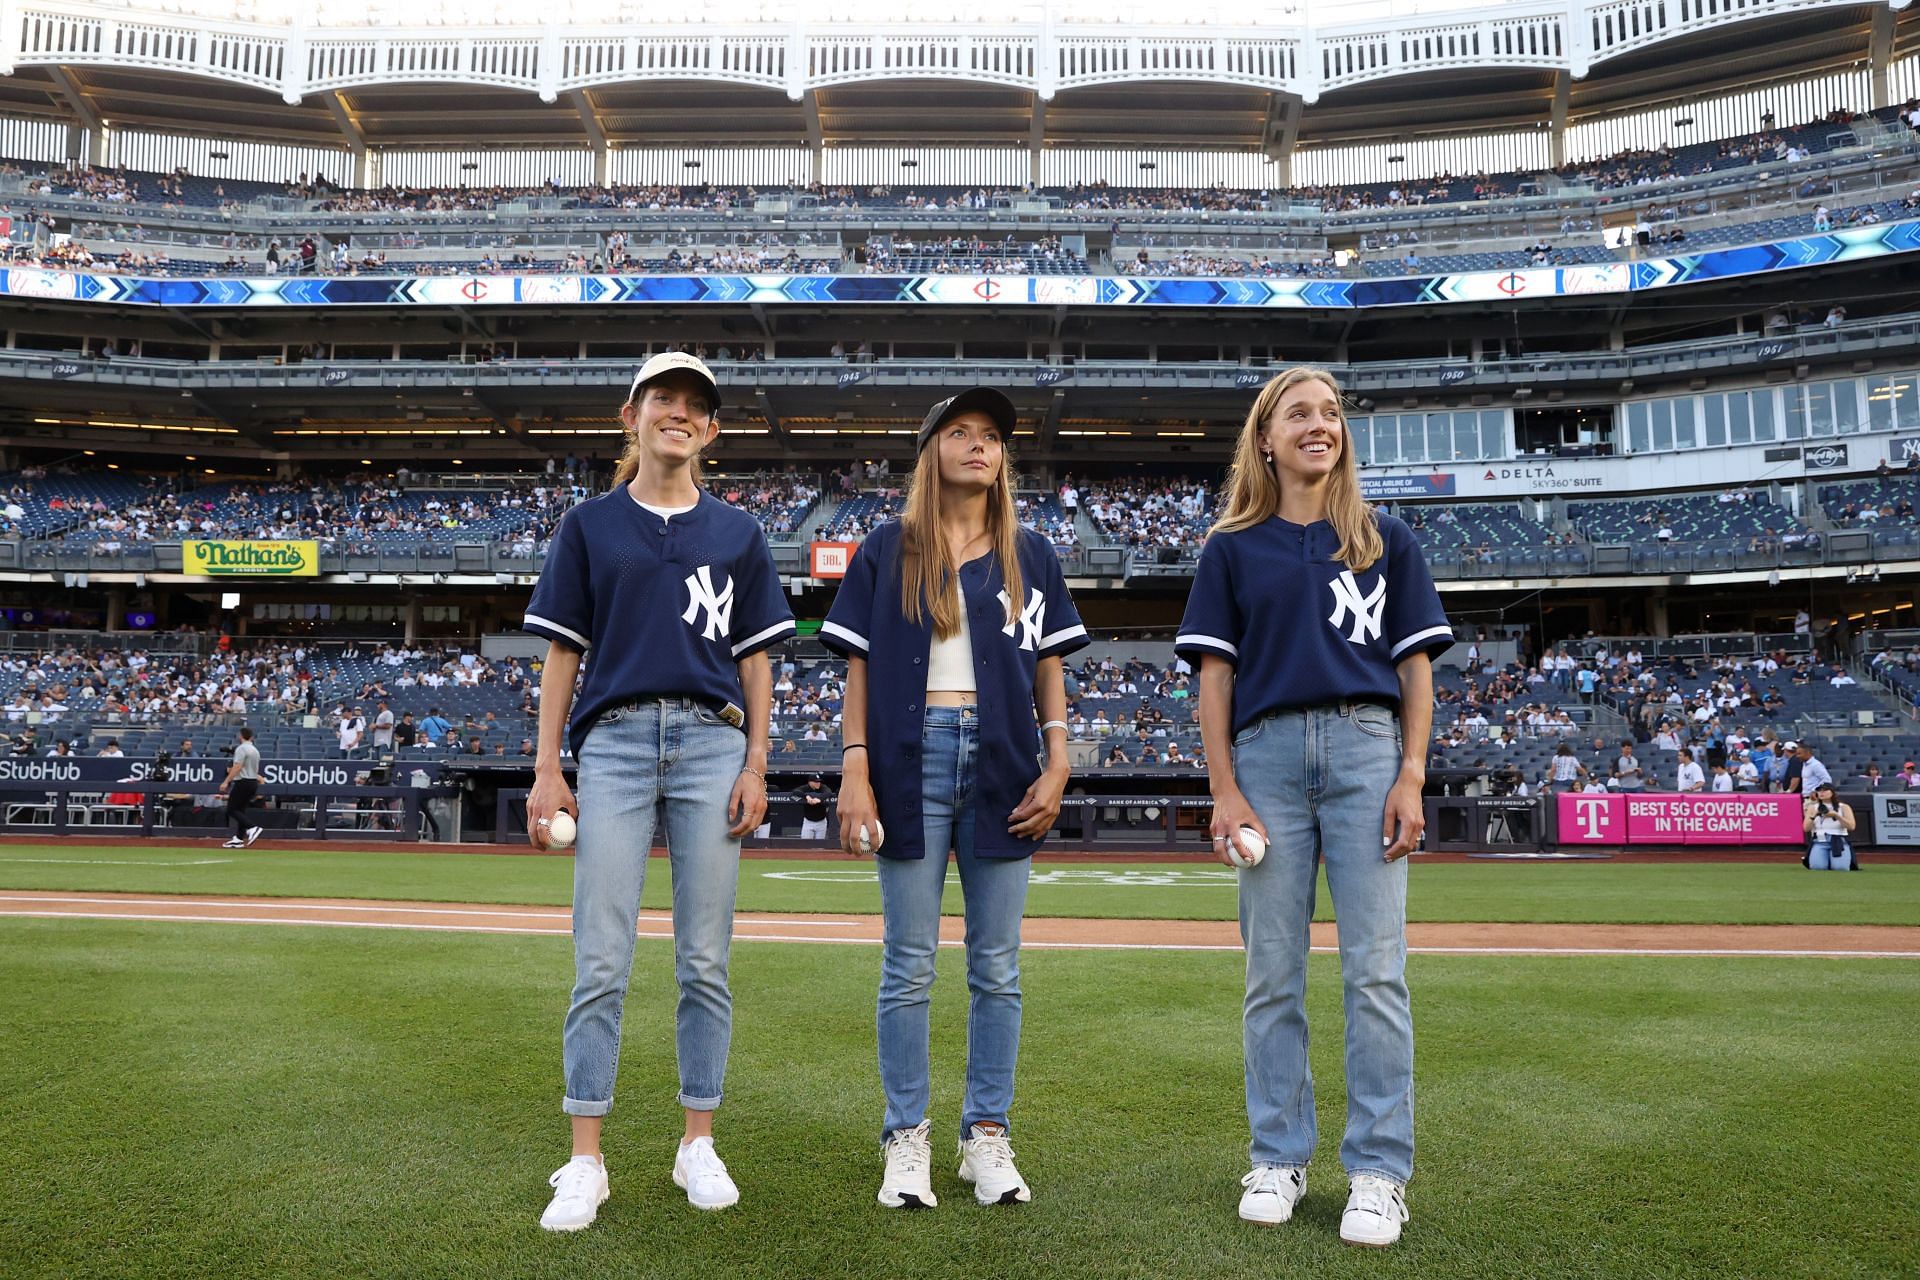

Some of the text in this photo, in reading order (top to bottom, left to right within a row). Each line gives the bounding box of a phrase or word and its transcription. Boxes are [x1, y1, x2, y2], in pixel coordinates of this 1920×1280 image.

[1037, 371, 1060, 382] 1947
[1237, 374, 1259, 384] 1949
[1441, 370, 1464, 380] 1950
[1501, 468, 1554, 479] DELTA
[1382, 479, 1404, 487] AIRLINE
[1574, 478, 1603, 486] SUITE
[1369, 487, 1383, 495] NEW
[195, 542, 304, 567] Nathan's
[823, 554, 841, 566] JBL
[681, 565, 734, 641] NY
[1328, 570, 1386, 645] NY
[0, 761, 80, 781] StubHub
[264, 764, 347, 785] StubHub
[1629, 802, 1778, 816] BEST 5G COVERAGE
[1655, 817, 1752, 832] IN THE GAME
